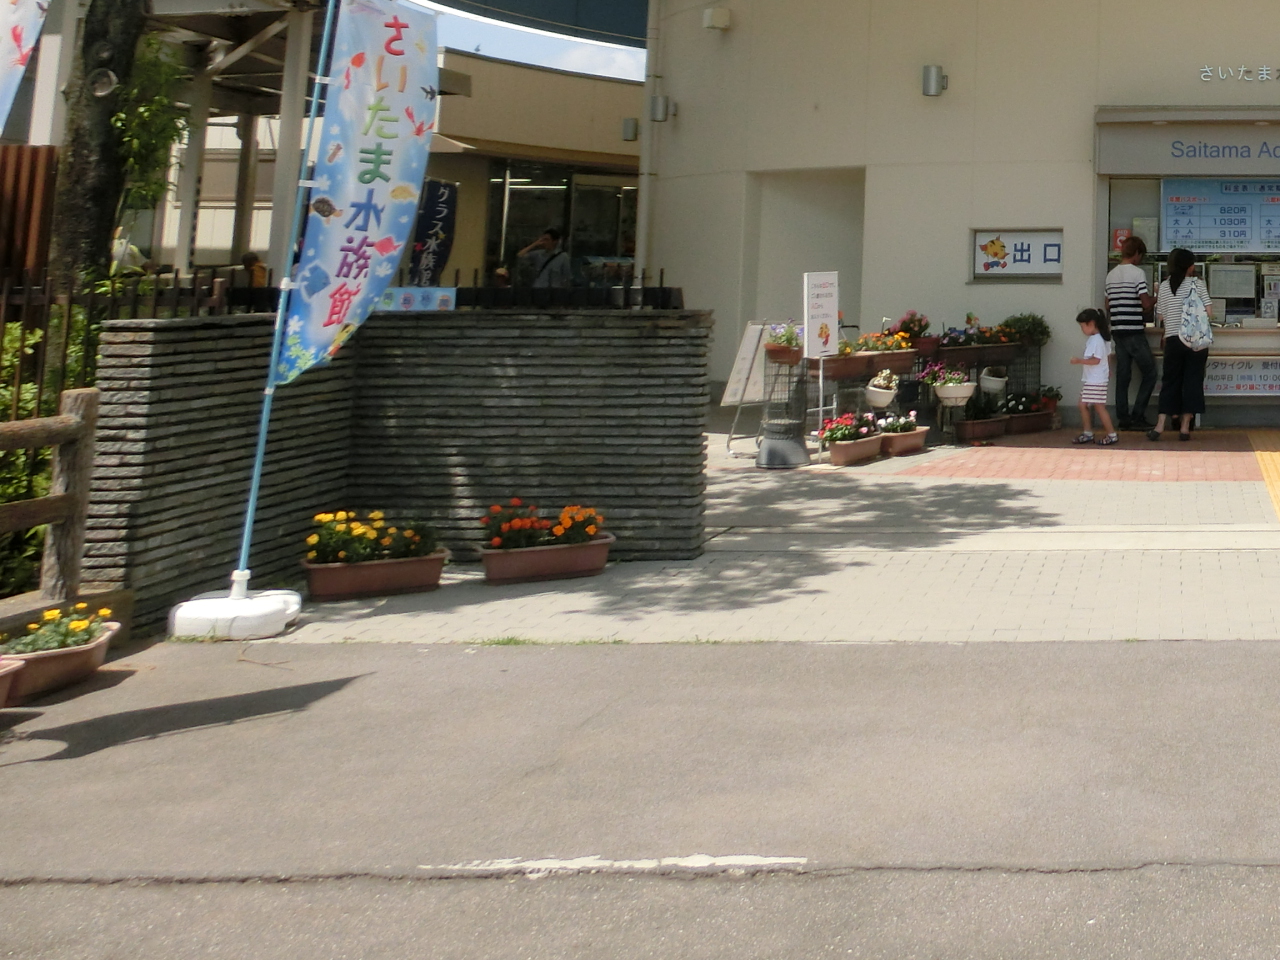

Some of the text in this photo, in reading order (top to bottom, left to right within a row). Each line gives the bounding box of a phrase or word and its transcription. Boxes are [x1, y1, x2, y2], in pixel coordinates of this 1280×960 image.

[1170, 141, 1251, 159] Saitama
[1219, 206, 1247, 214] 820円
[1213, 218, 1247, 226] 1030円
[1219, 230, 1247, 238] 310円
[1012, 242, 1061, 264] 出口
[1204, 361, 1254, 370] ンタサイクル
